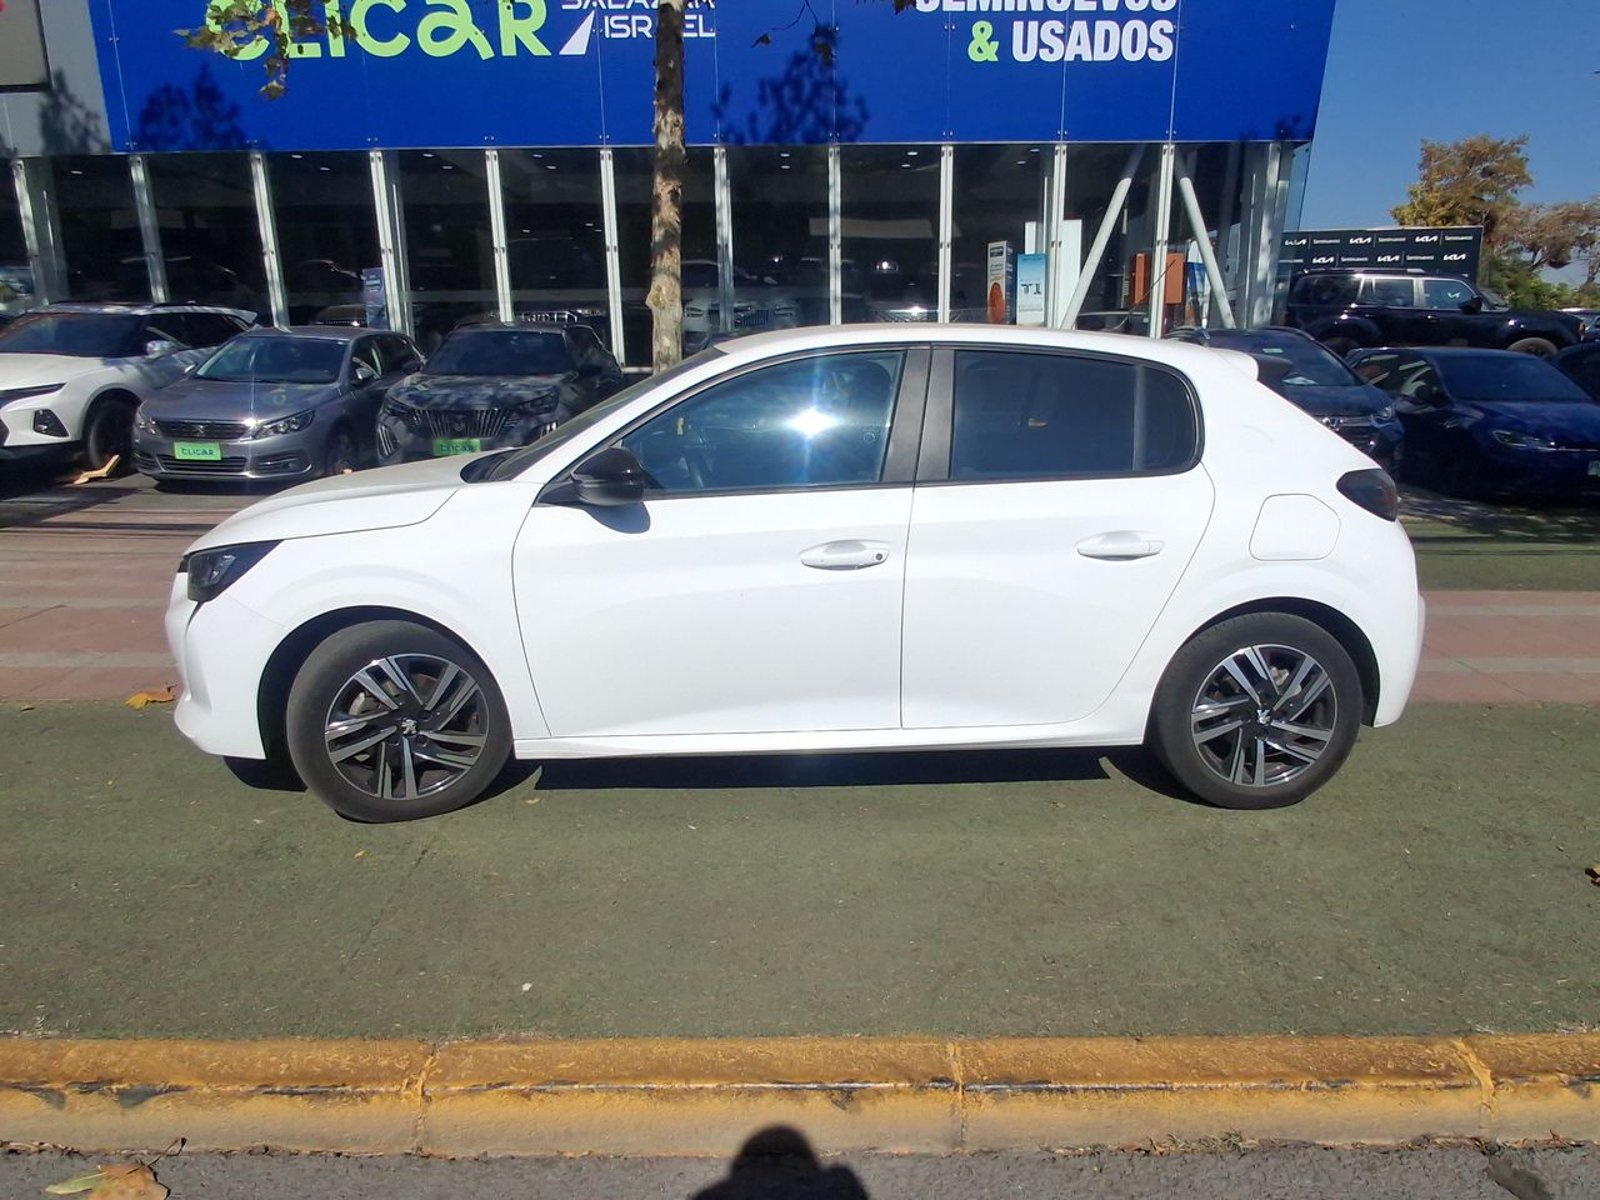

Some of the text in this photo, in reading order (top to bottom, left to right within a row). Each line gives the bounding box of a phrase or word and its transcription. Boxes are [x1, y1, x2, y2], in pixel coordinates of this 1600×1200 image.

[604, 15, 716, 39] ISREL
[967, 19, 1174, 62] & USADOS
